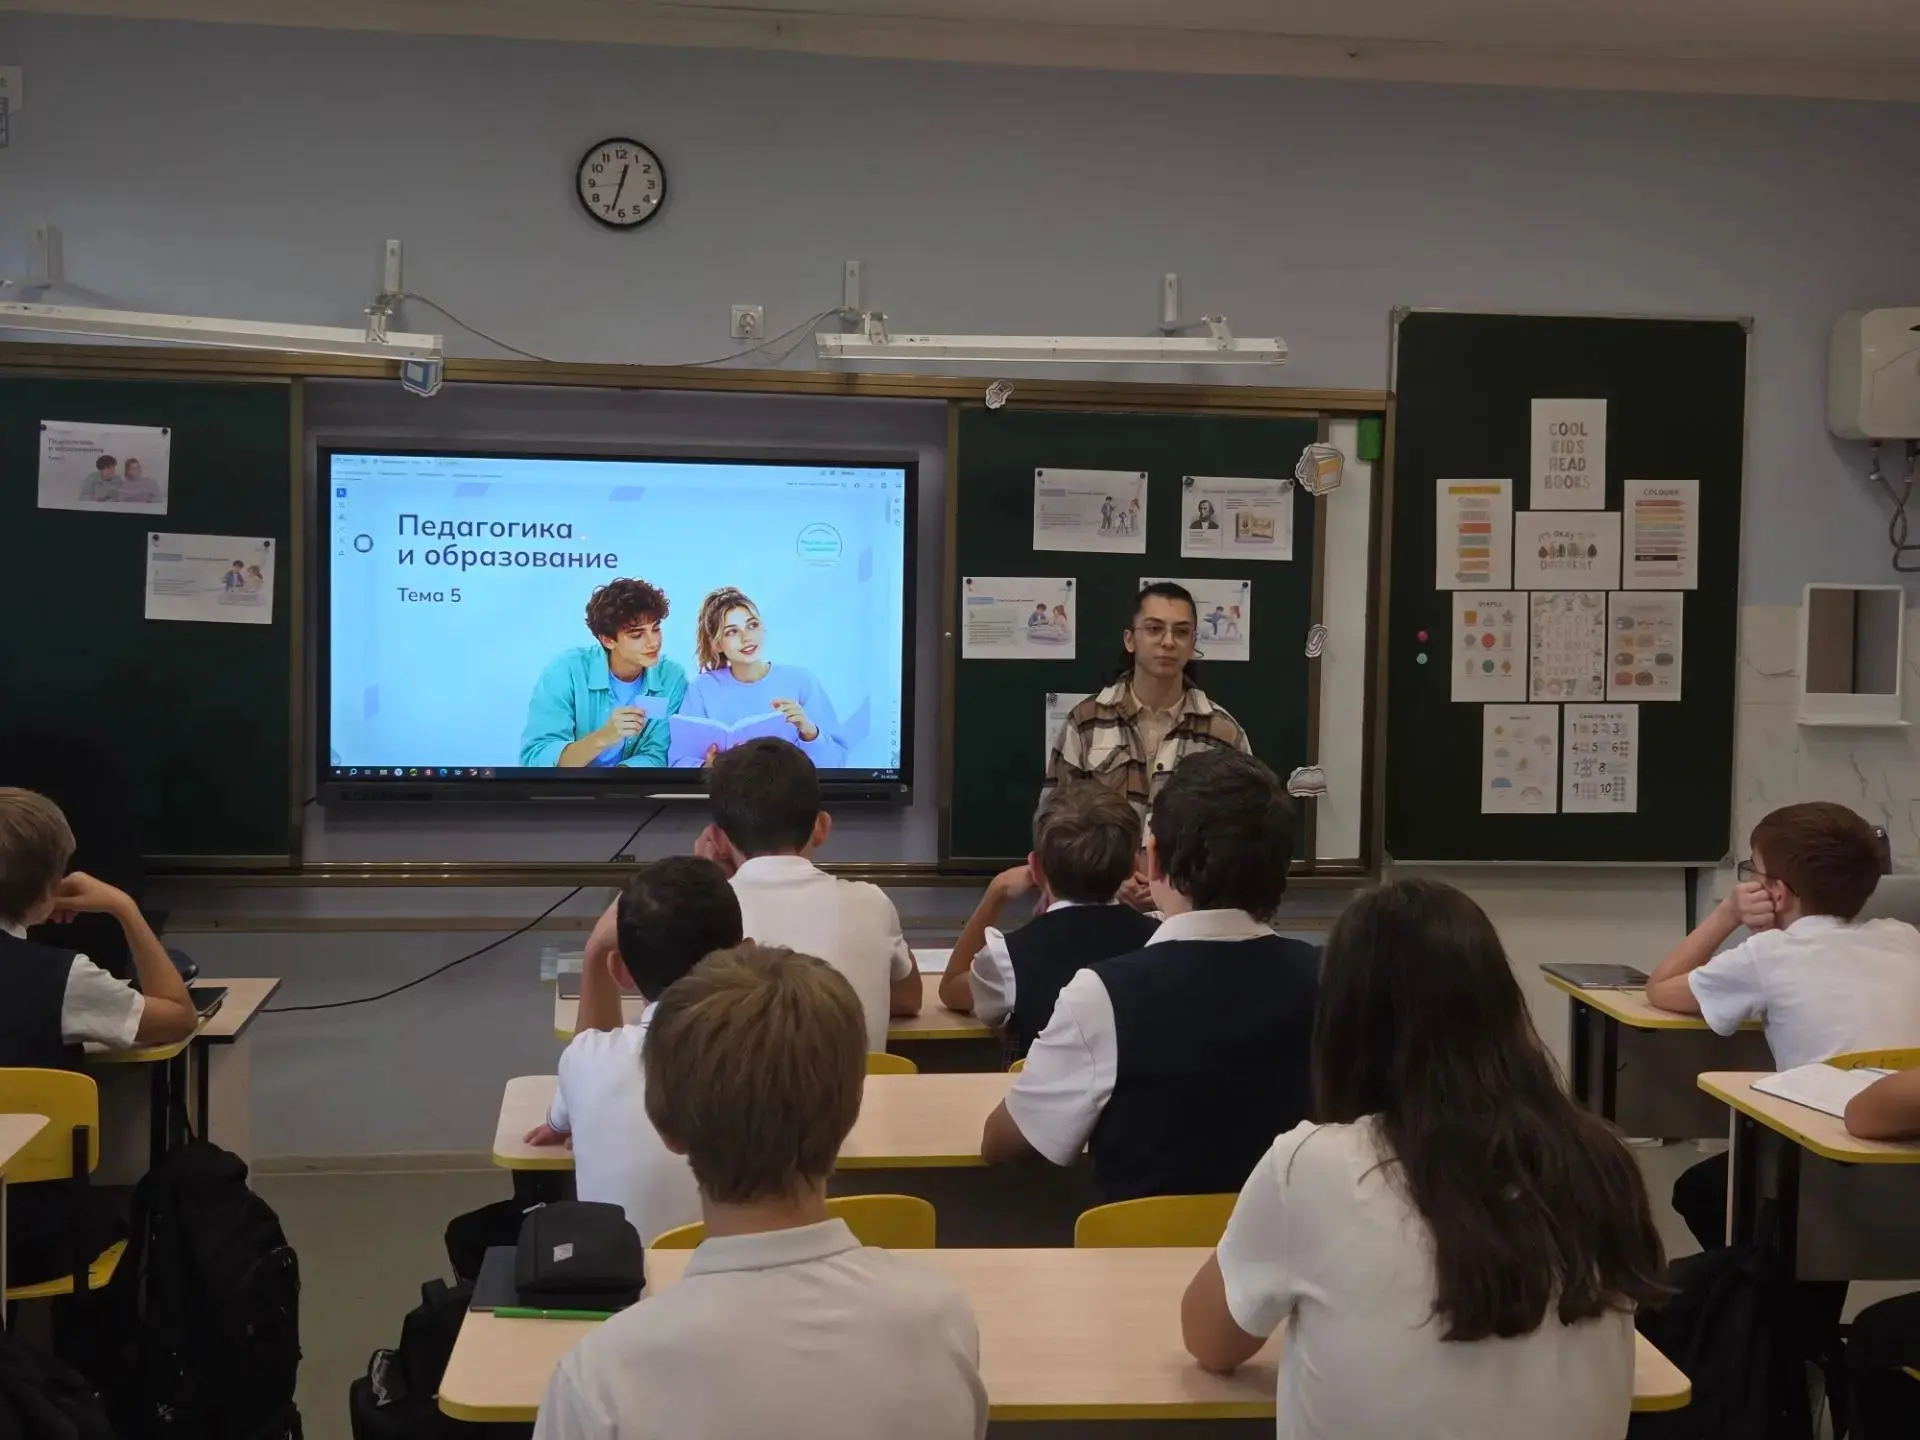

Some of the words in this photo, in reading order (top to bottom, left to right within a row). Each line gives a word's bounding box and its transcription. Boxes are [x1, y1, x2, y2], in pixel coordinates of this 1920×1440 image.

[602, 152, 610, 163] 11
[615, 149, 628, 159] 12
[635, 154, 639, 164] 1
[592, 163, 604, 173] 10
[642, 164, 651, 174] 2
[588, 178, 596, 188] 9
[647, 180, 655, 190] 3
[592, 193, 600, 203] 8
[643, 194, 651, 204] 4
[603, 204, 611, 214] 7
[617, 208, 626, 218] 6
[632, 205, 641, 215] 5
[1548, 421, 1588, 437] COOL
[1548, 457, 1586, 472] READ
[1544, 474, 1591, 490] BOOKS
[398, 514, 573, 540] Педагогика
[398, 548, 414, 565] и
[424, 543, 619, 572] образование
[397, 587, 444, 602] Тема
[450, 588, 462, 603] 5
